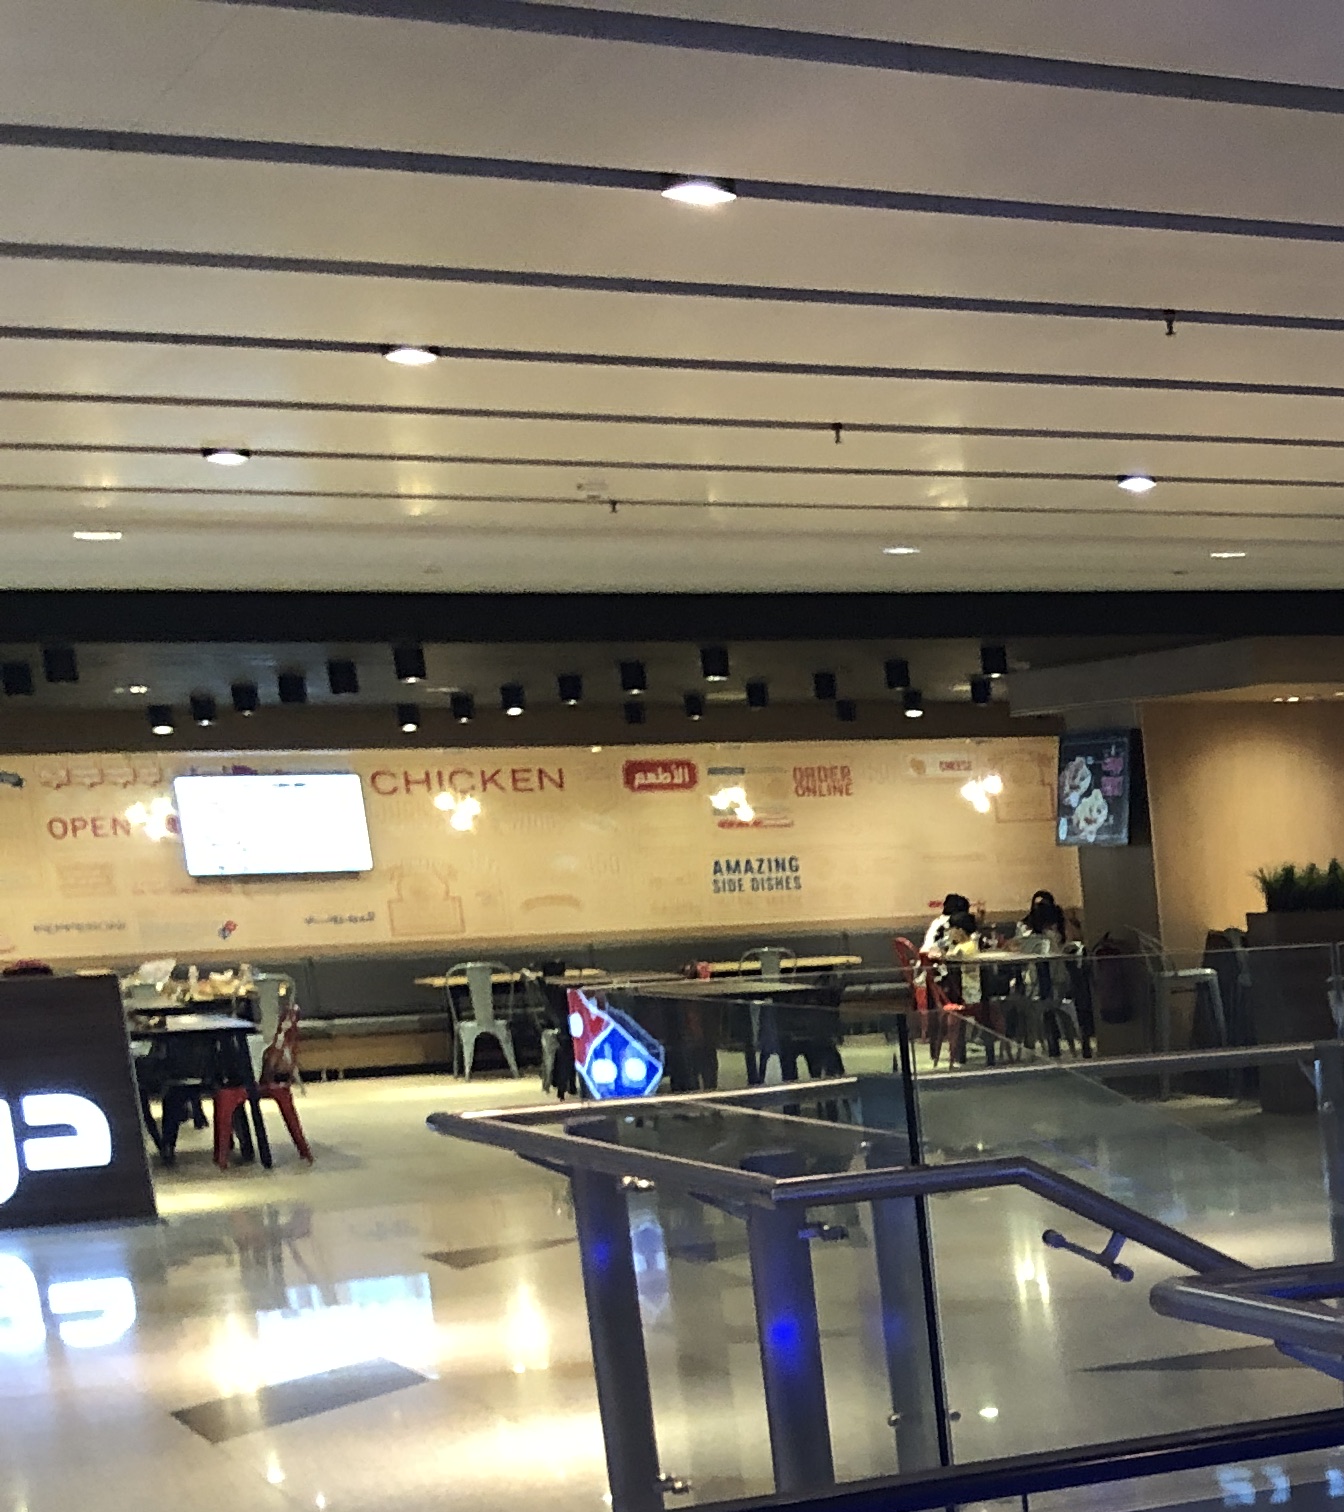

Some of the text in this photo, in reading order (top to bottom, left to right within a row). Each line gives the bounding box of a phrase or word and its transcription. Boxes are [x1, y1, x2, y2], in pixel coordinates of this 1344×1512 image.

[370, 767, 565, 796] CHICKEN
[46, 816, 132, 840] OPEN
[712, 856, 800, 876] AMAZING
[712, 875, 802, 894] SIDE DISHES
